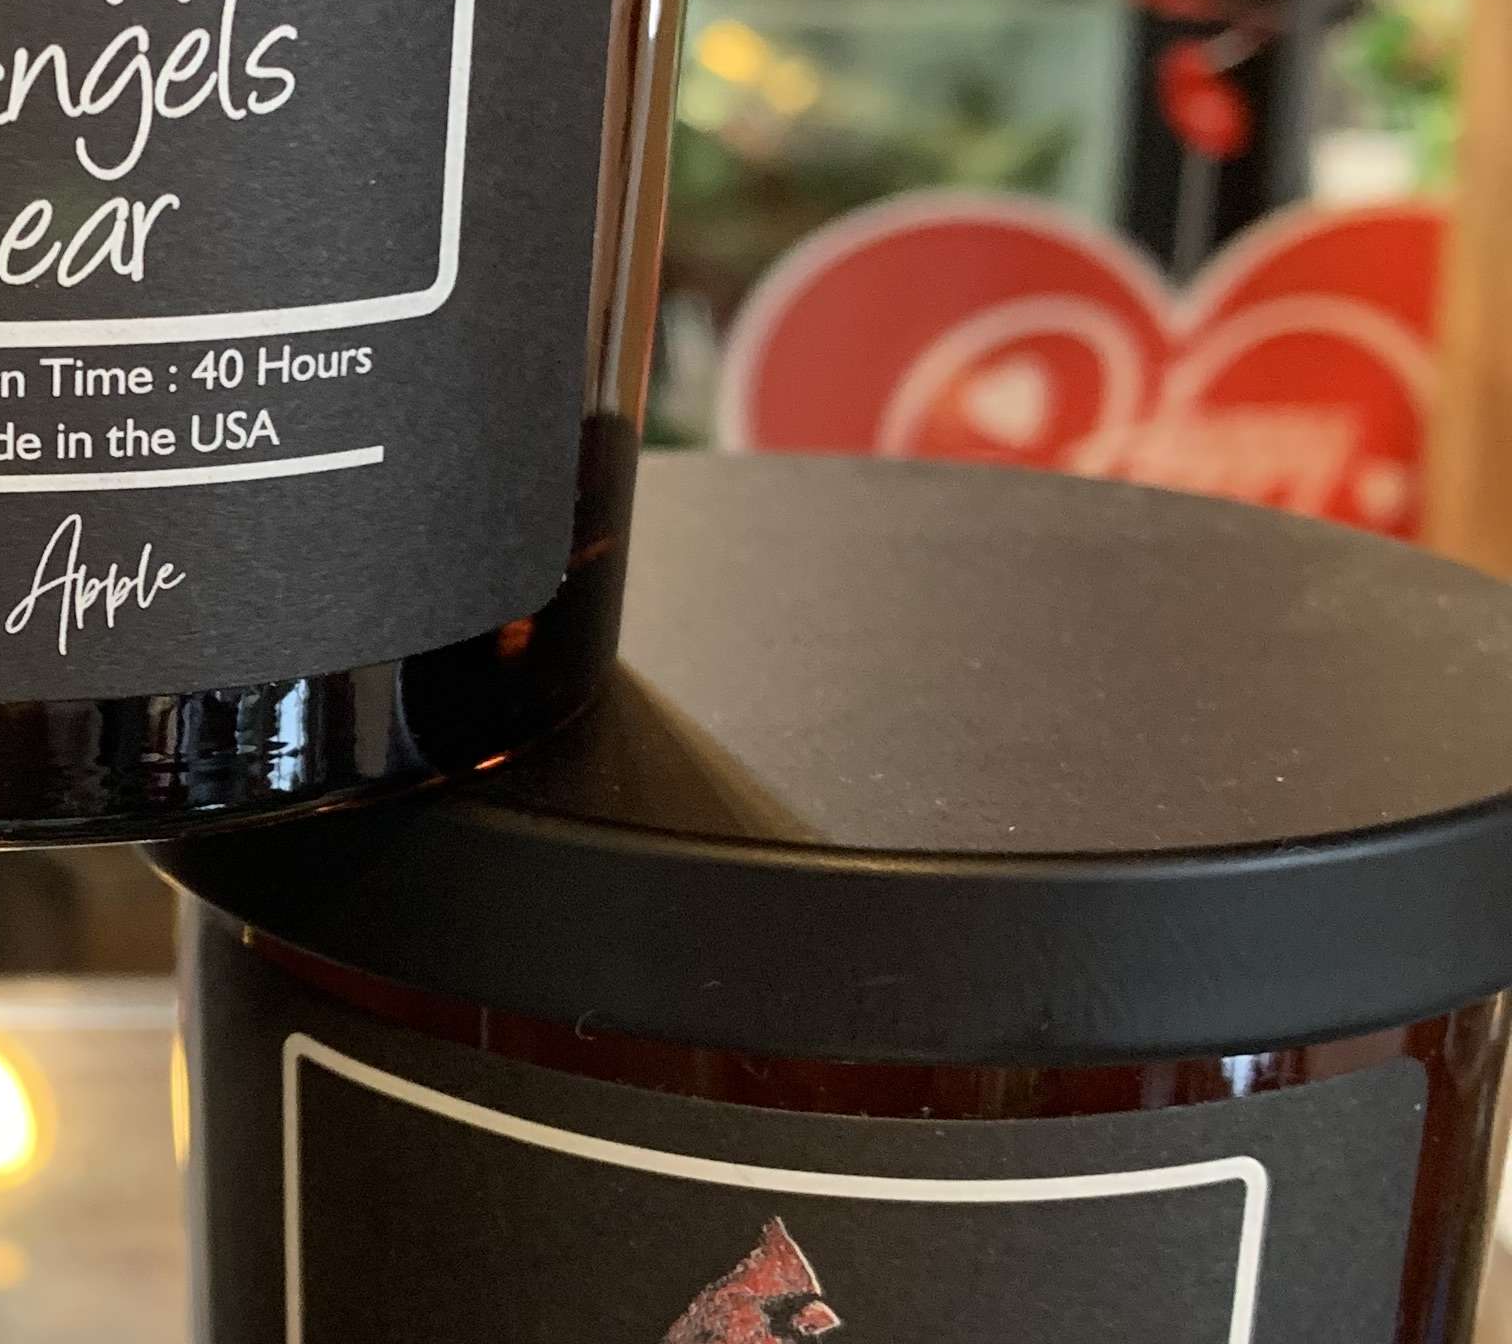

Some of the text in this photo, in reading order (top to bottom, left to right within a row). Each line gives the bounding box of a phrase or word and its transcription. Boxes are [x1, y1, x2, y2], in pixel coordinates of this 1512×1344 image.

[40, 358, 153, 395] Time
[192, 353, 244, 388] 40
[258, 345, 372, 385] Hours
[58, 423, 92, 458] in
[106, 419, 176, 457] the
[192, 409, 280, 452] USA
[5, 513, 185, 654] Apple
